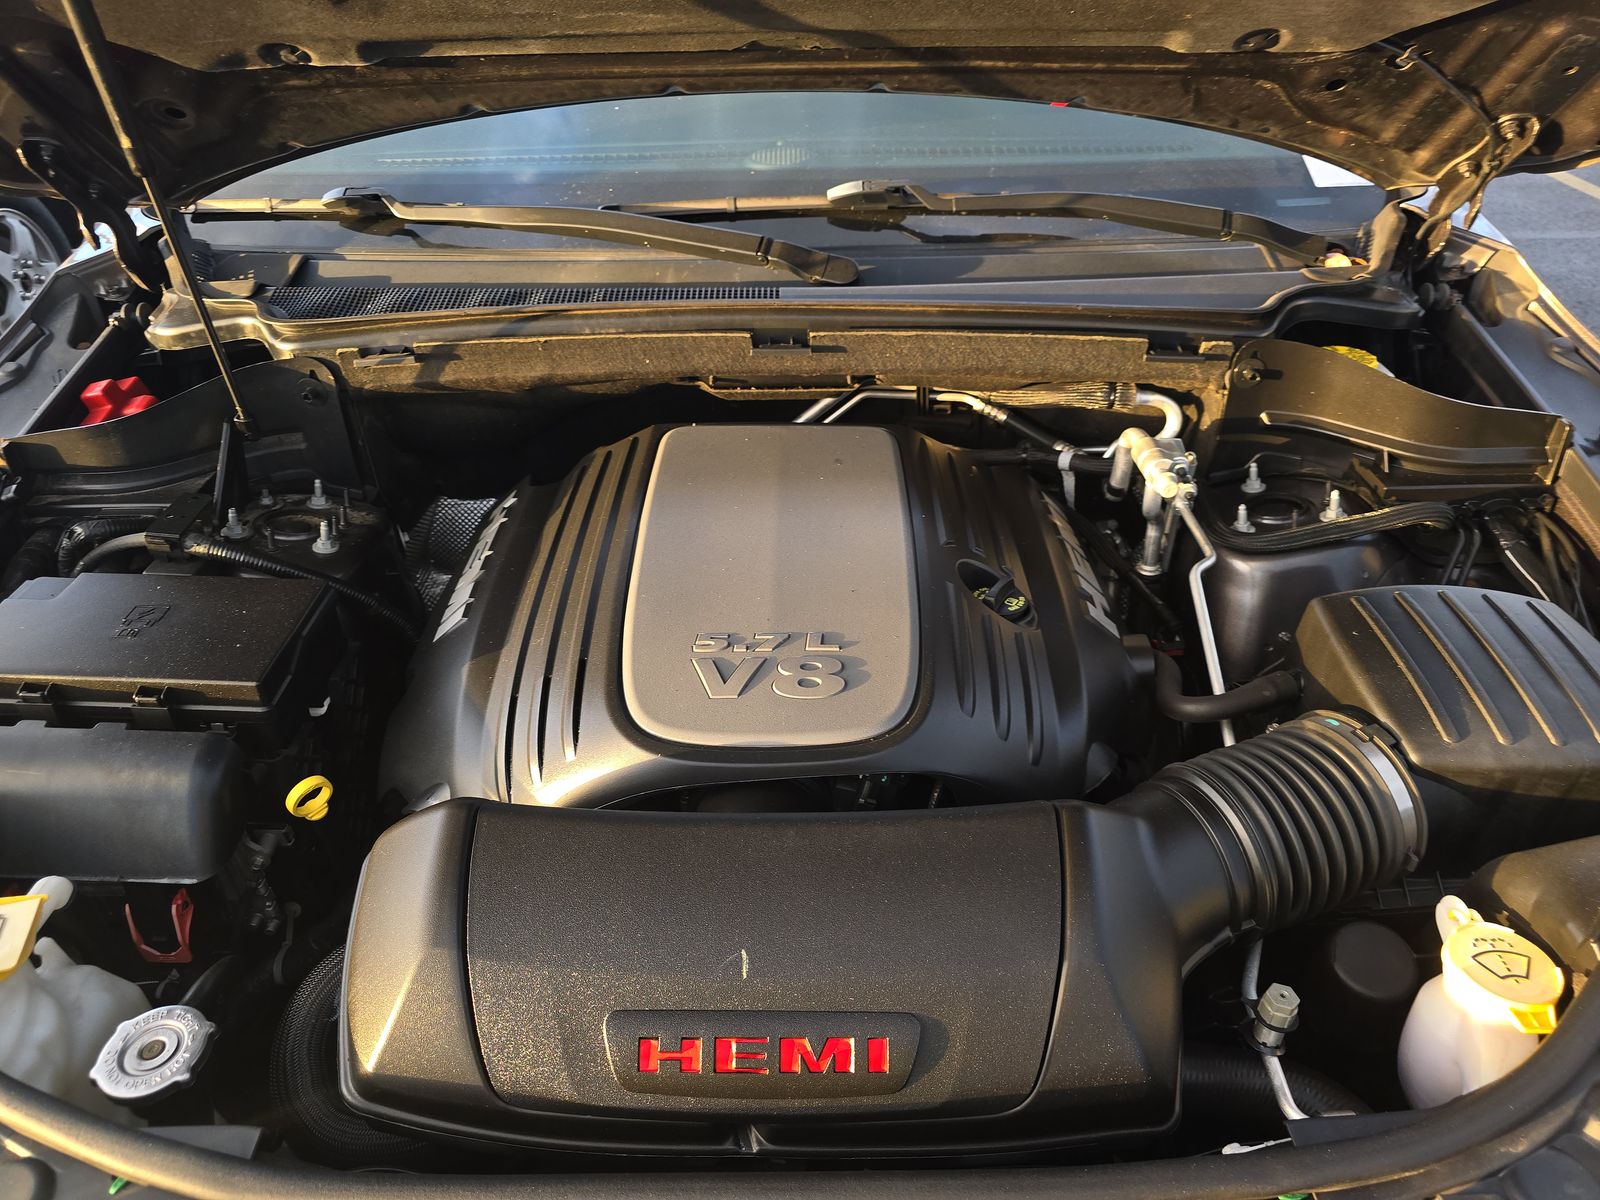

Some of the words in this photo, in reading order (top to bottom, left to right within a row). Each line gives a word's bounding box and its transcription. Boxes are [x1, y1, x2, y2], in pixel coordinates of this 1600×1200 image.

[690, 656, 847, 700] V8
[132, 1010, 169, 1031] KEEP
[638, 1036, 890, 1074] HEMI
